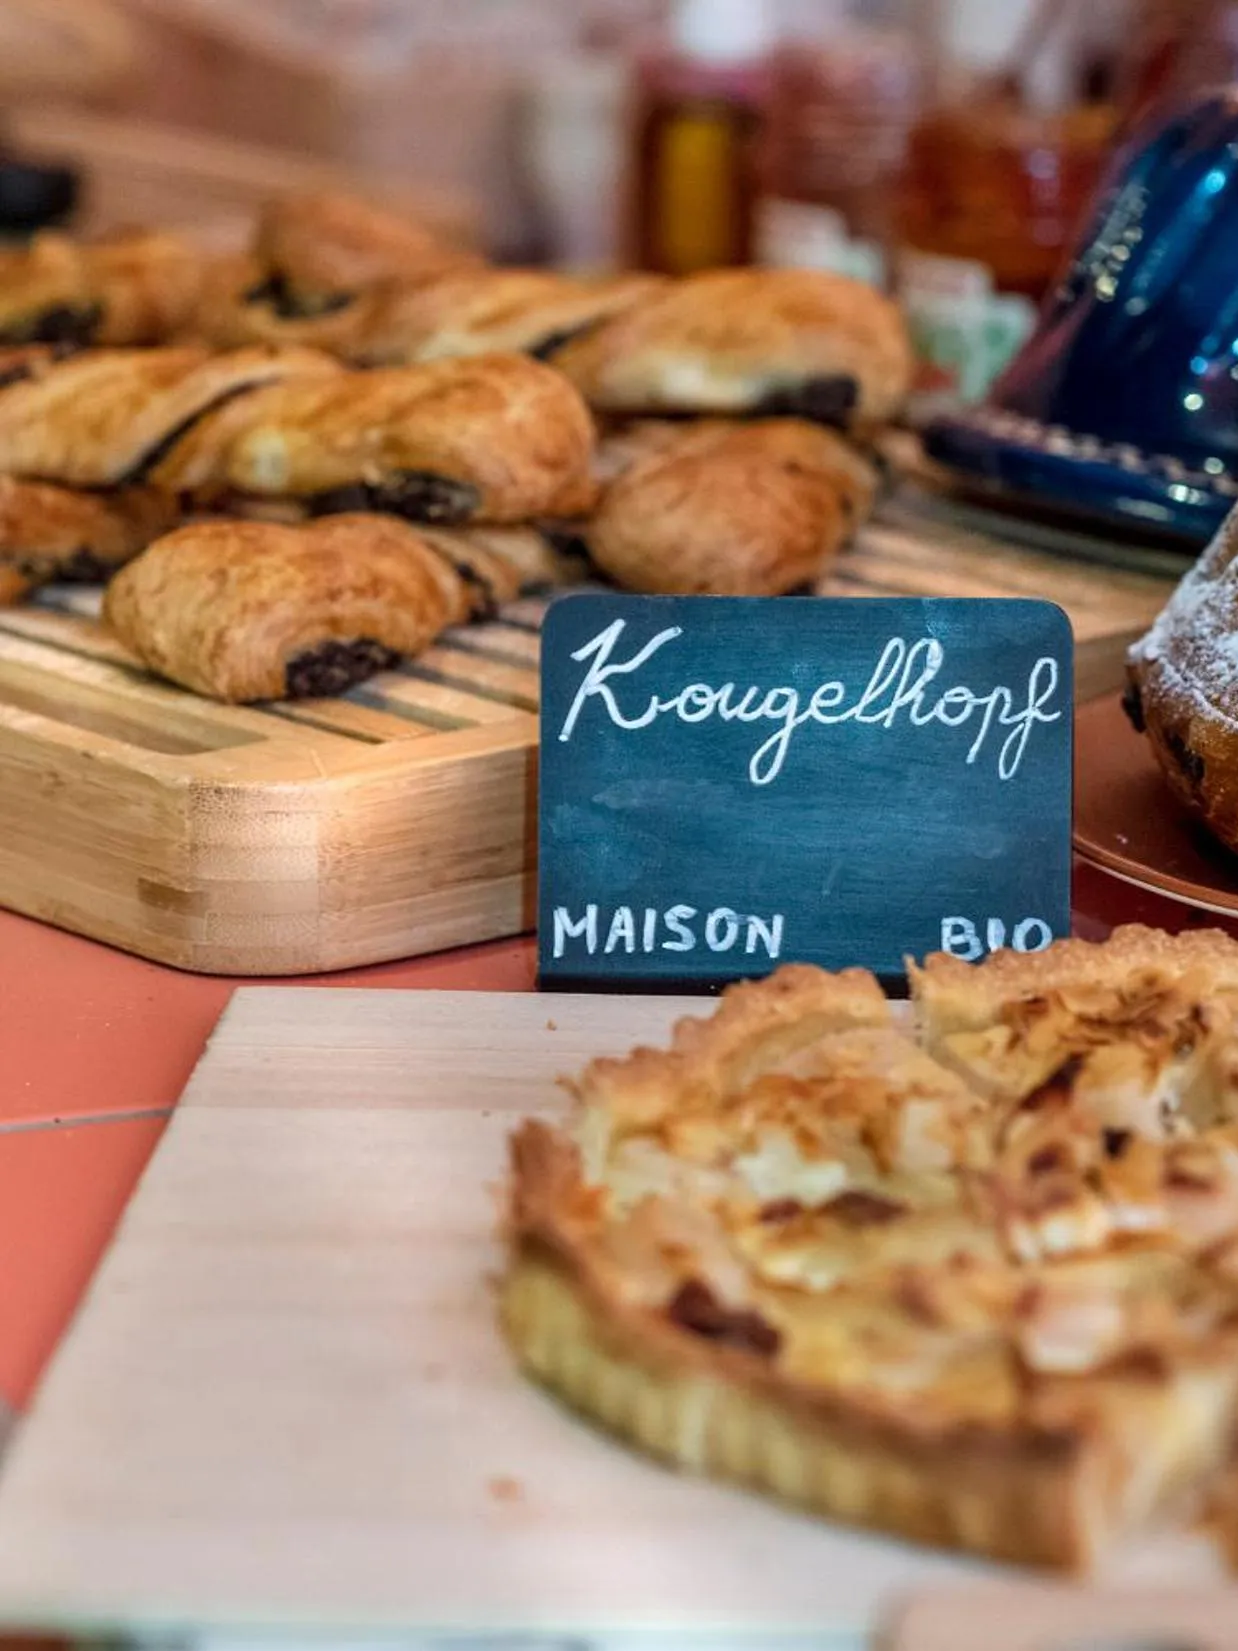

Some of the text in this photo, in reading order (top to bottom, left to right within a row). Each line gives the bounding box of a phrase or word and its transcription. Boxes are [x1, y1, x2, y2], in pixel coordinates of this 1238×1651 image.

[559, 618, 1062, 784] Kougelhopf
[552, 904, 1053, 962] MAISON BIO
